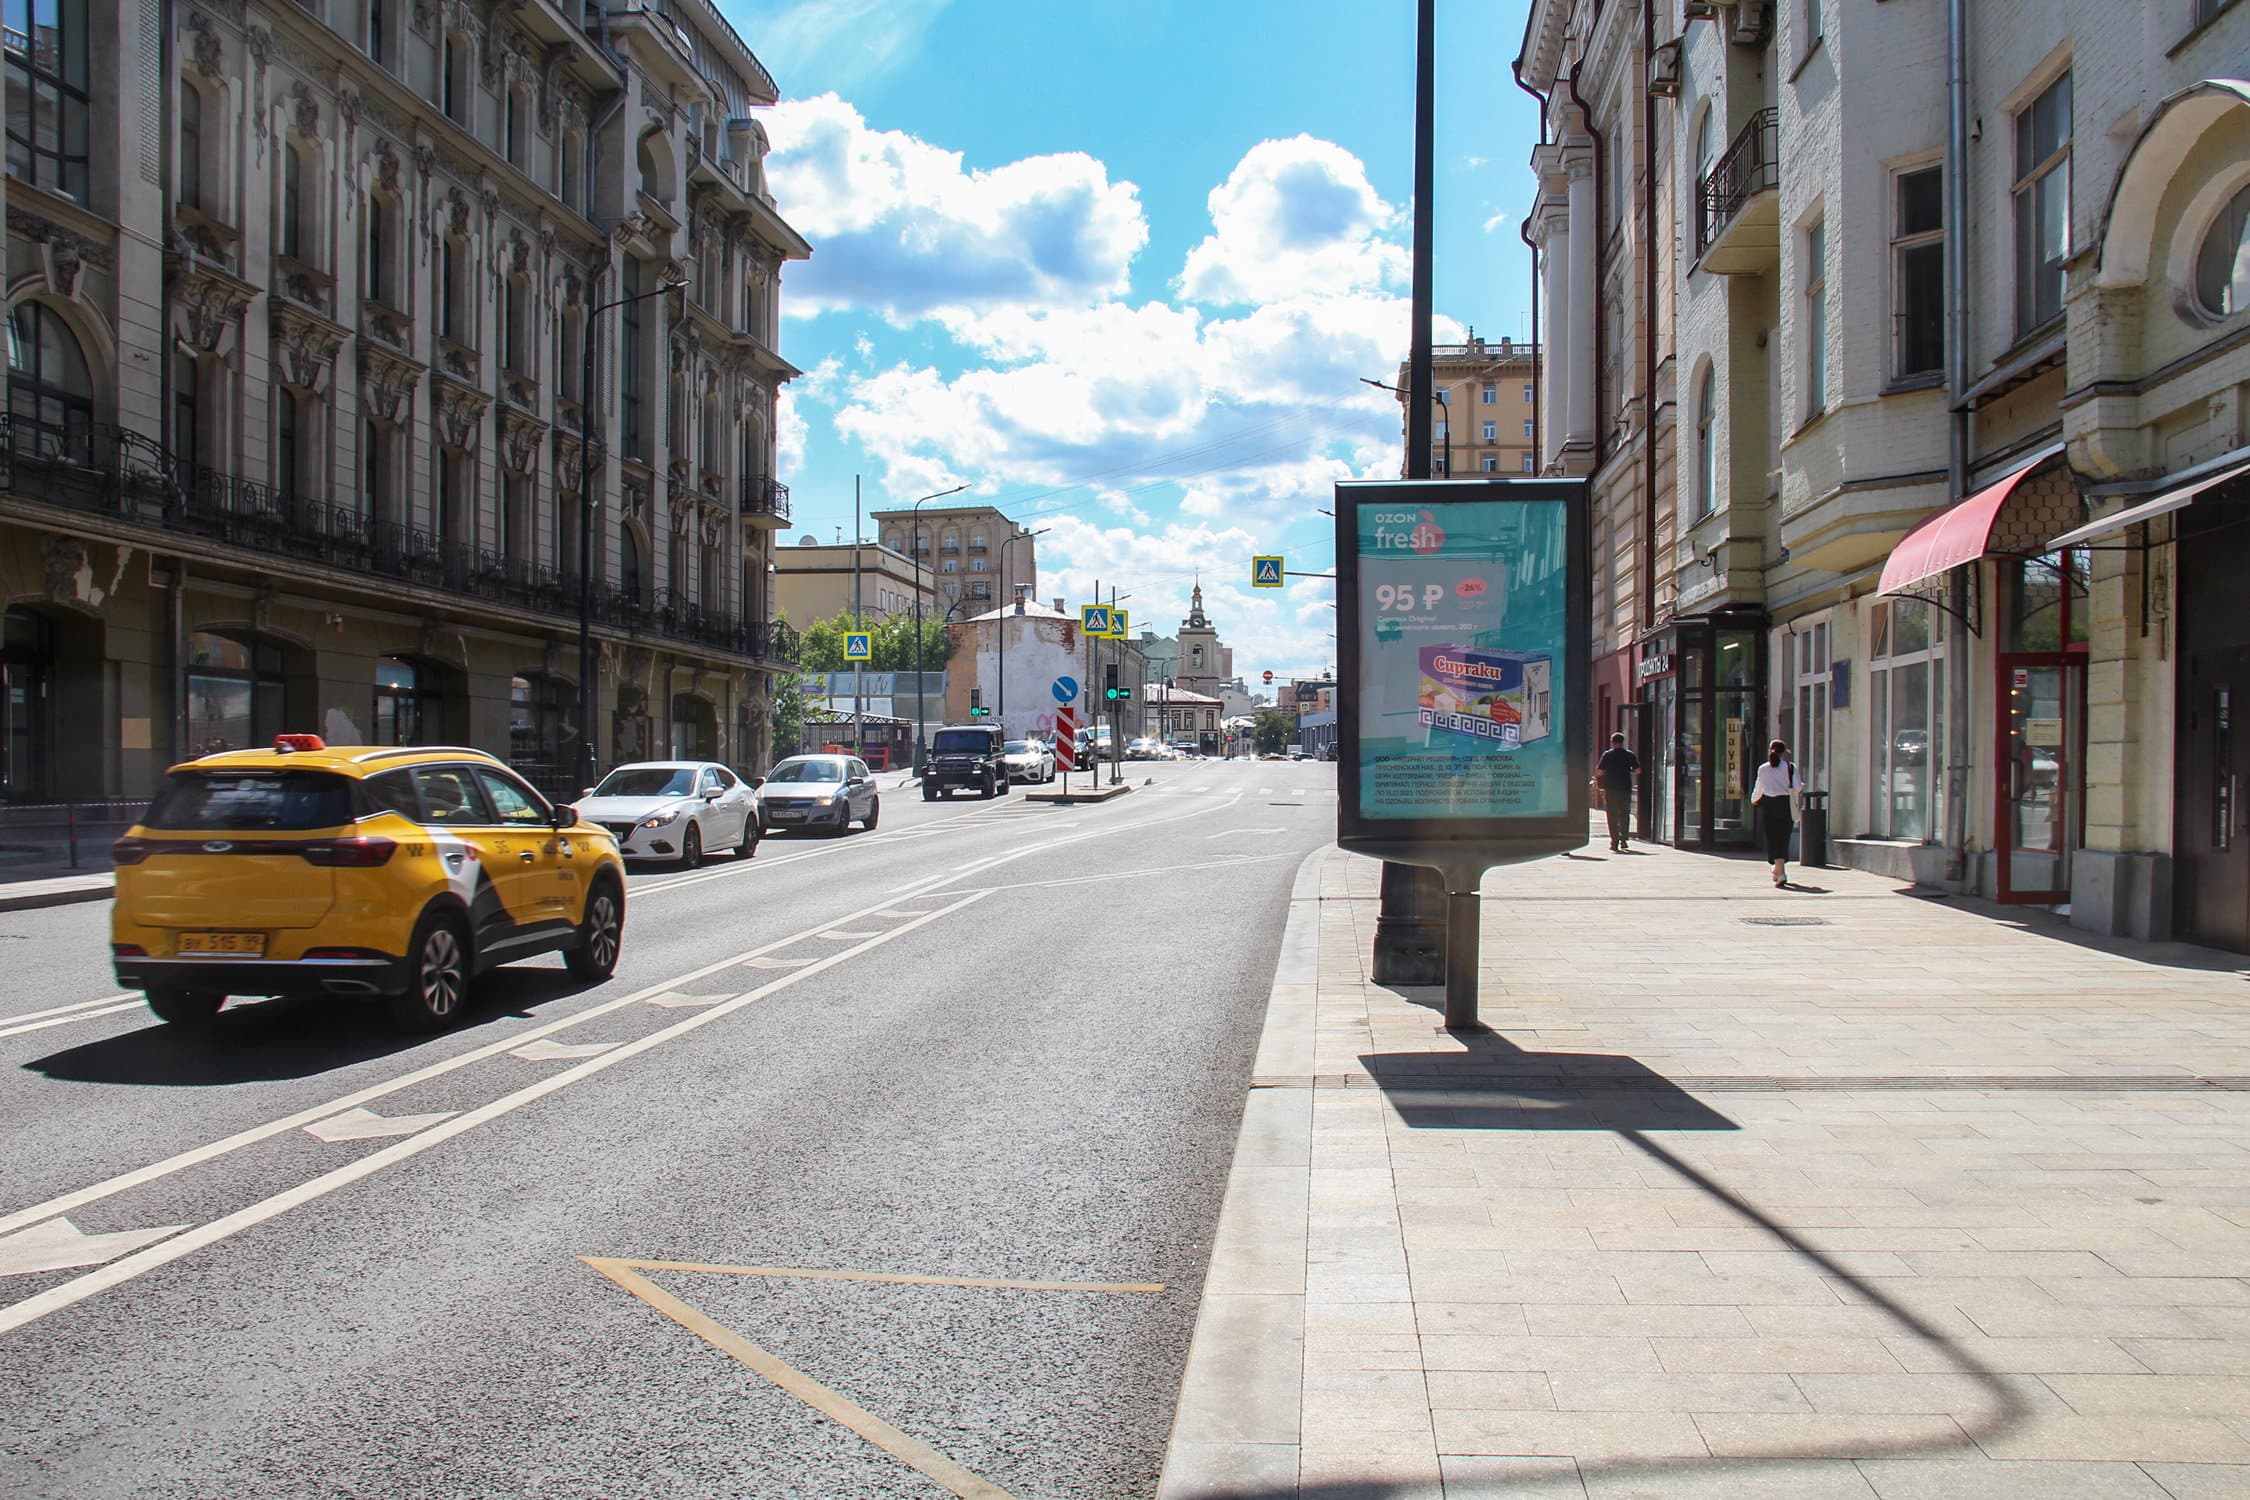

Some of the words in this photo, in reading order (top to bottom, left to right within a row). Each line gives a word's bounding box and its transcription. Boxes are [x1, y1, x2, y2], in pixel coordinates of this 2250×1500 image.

[1375, 513, 1416, 523] OZON
[1375, 527, 1436, 549] fresh
[1376, 585, 1415, 611] 95
[1727, 723, 1740, 794] Шаурма
